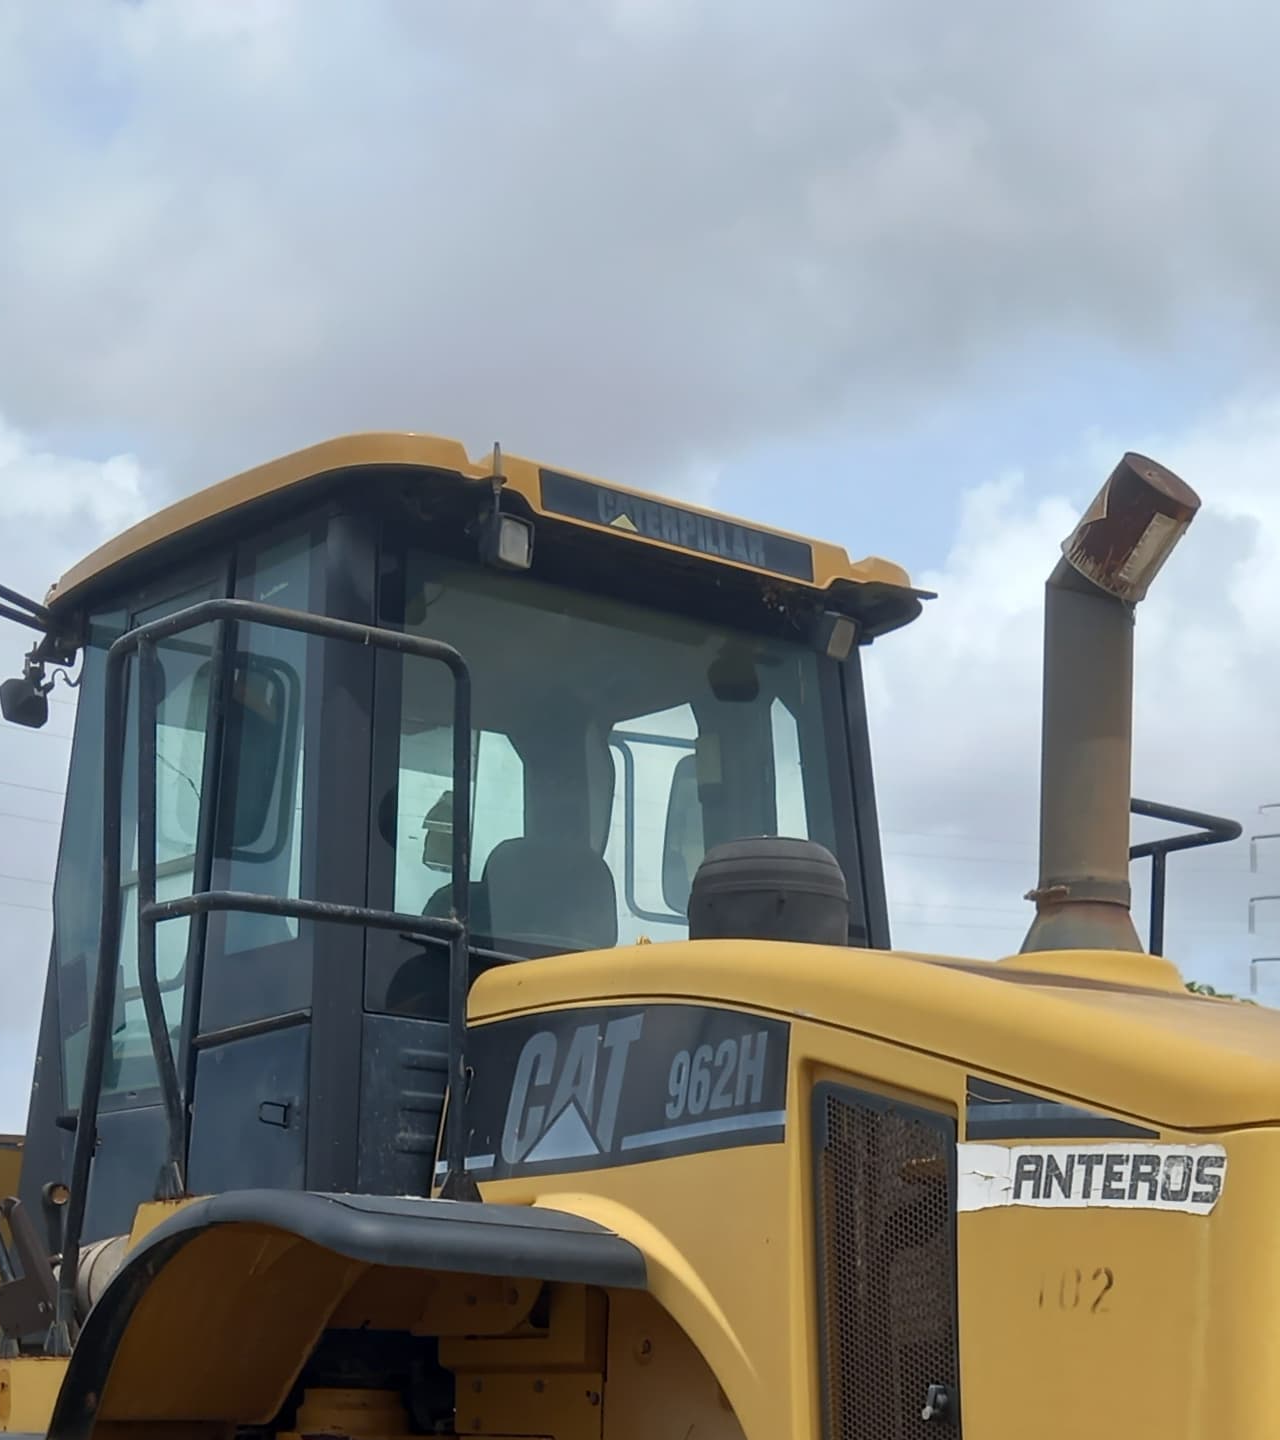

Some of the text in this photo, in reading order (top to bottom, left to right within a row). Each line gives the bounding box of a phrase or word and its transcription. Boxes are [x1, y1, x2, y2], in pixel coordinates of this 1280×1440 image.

[597, 489, 767, 568] CATERPILLAR
[501, 1013, 766, 1164] CAT 962H
[1012, 1154, 1226, 1204] ANTEROS
